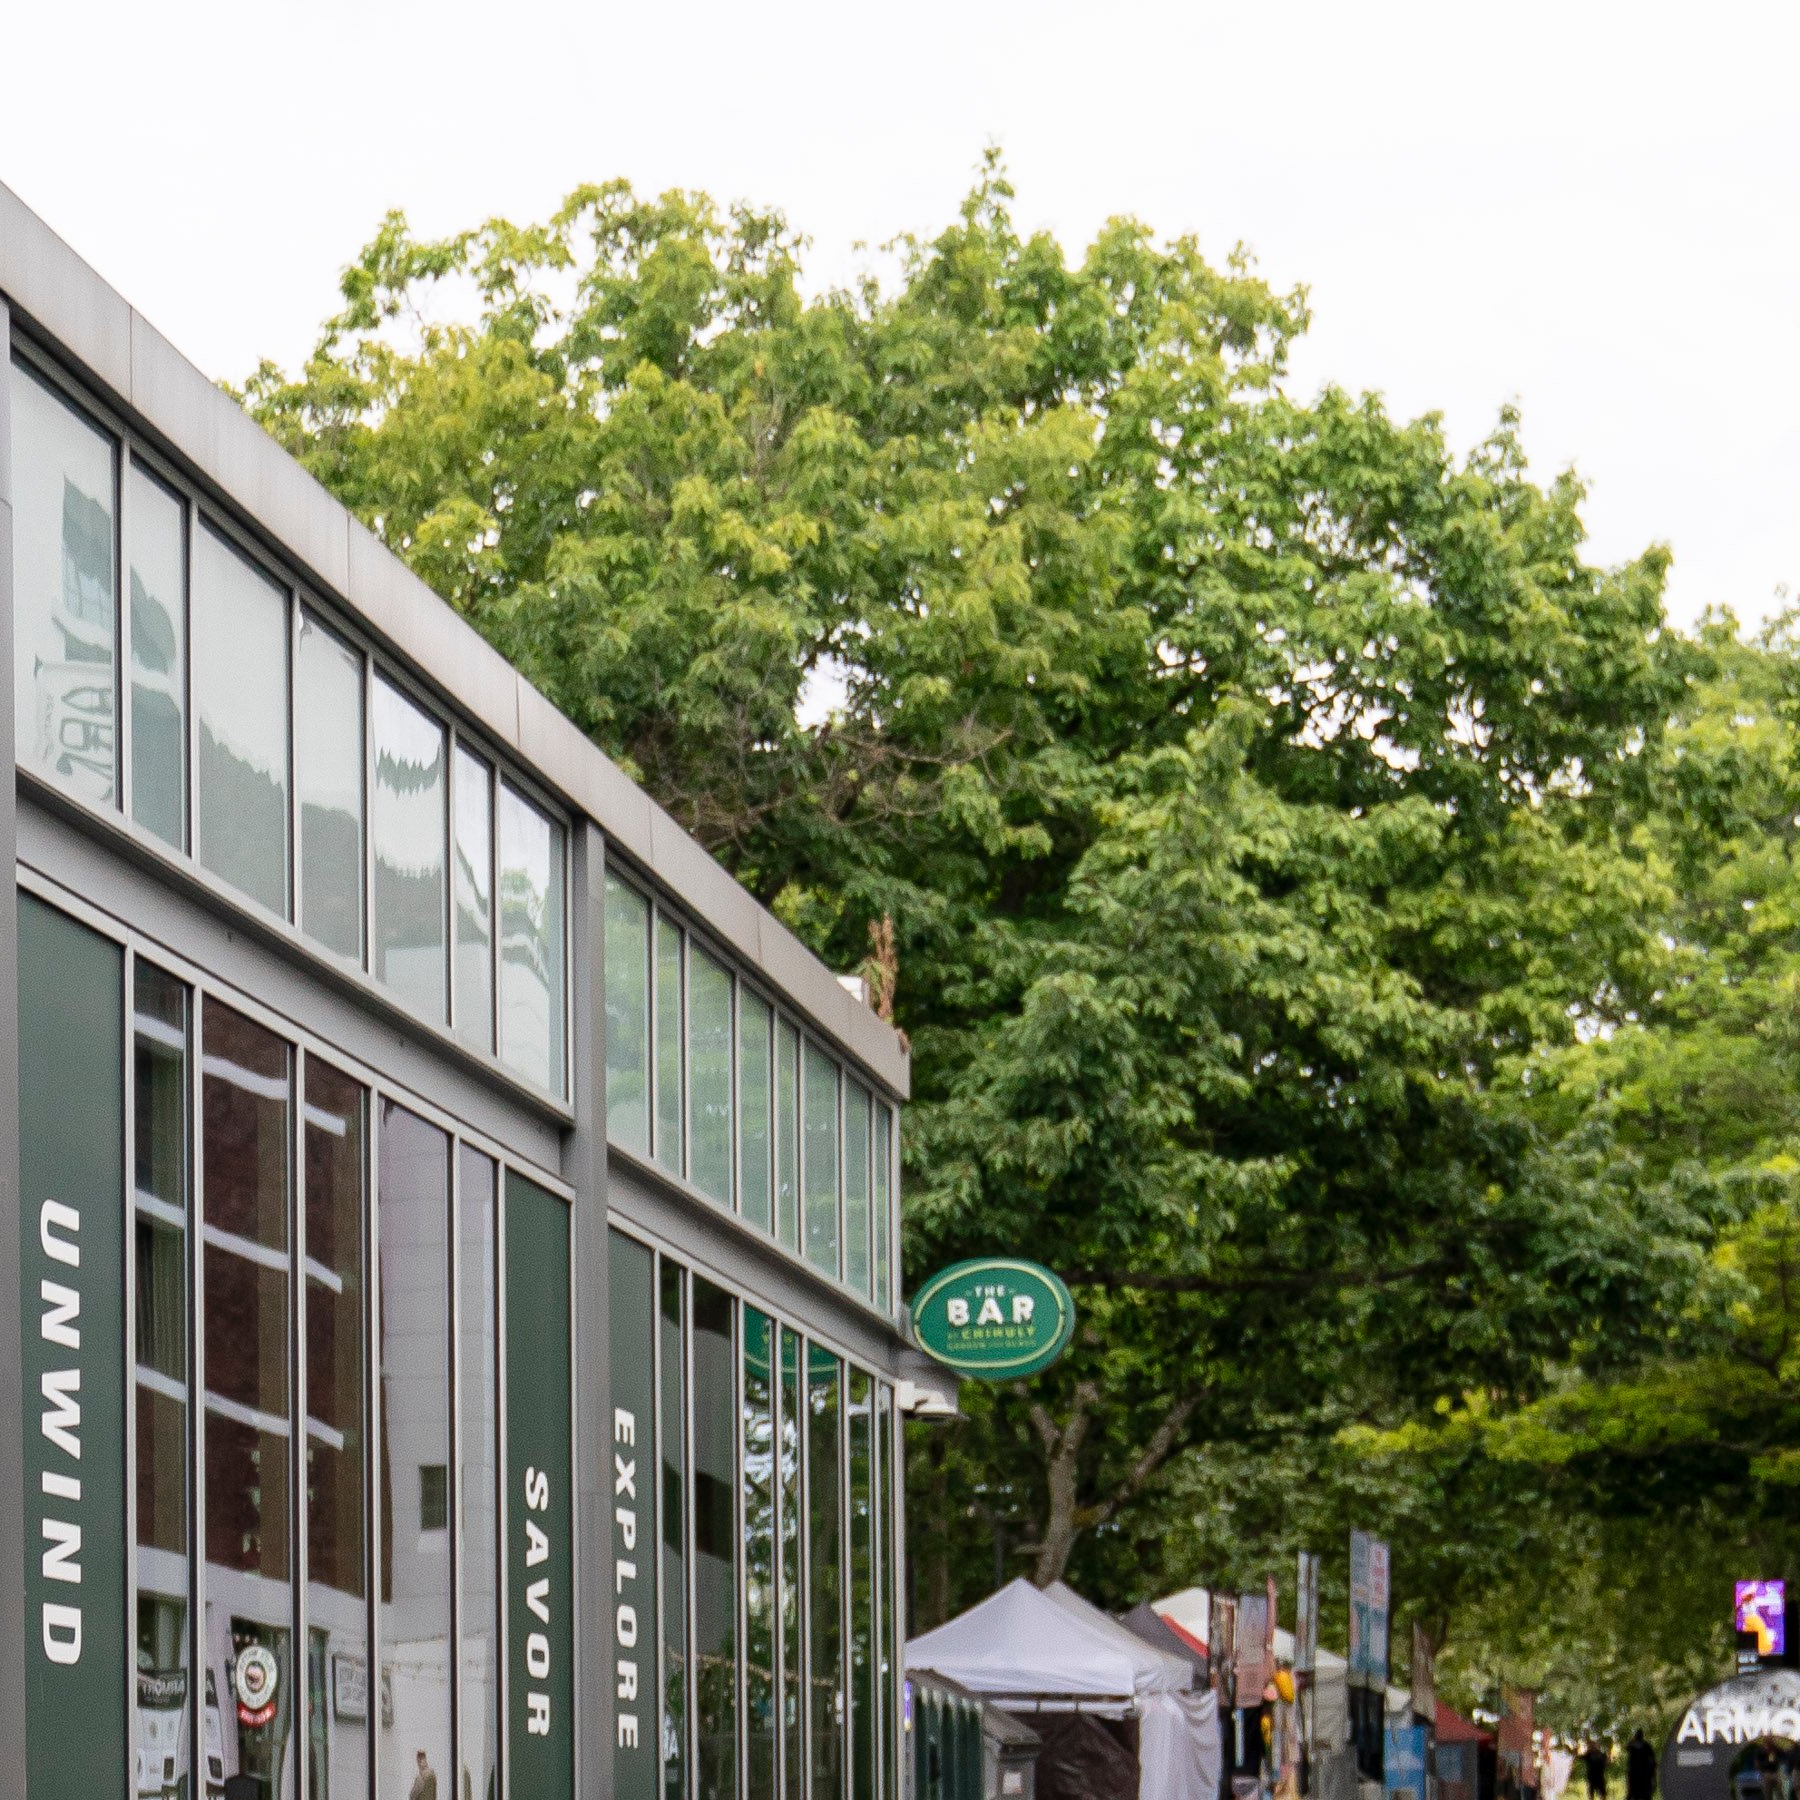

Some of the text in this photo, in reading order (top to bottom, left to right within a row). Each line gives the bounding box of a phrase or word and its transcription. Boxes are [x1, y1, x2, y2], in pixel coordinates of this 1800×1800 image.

[40, 1199, 82, 1665] UNWIND
[947, 1295, 1035, 1327] BAR
[525, 1466, 551, 1736] SAVOR
[614, 1406, 639, 1749] EXPLORE
